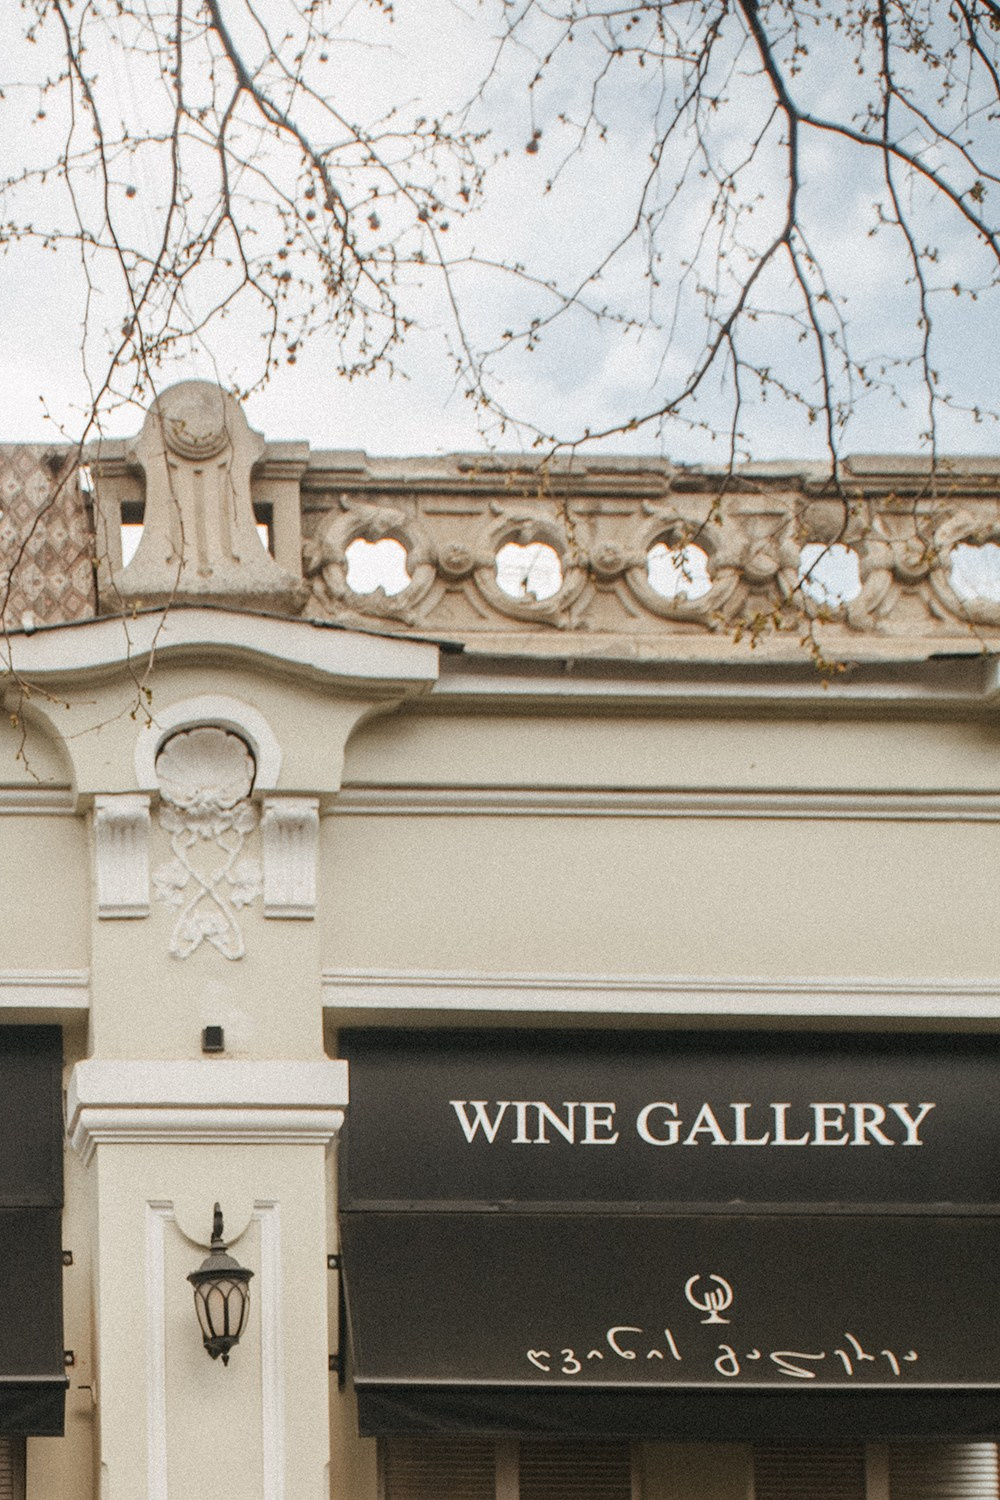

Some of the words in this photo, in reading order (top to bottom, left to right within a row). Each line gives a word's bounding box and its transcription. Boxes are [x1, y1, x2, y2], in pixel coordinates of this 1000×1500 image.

[448, 1100, 620, 1145] WINE
[636, 1101, 937, 1147] GALLERY
[526, 1326, 682, 1375] ღვინის
[714, 1333, 919, 1379] გალერეა
